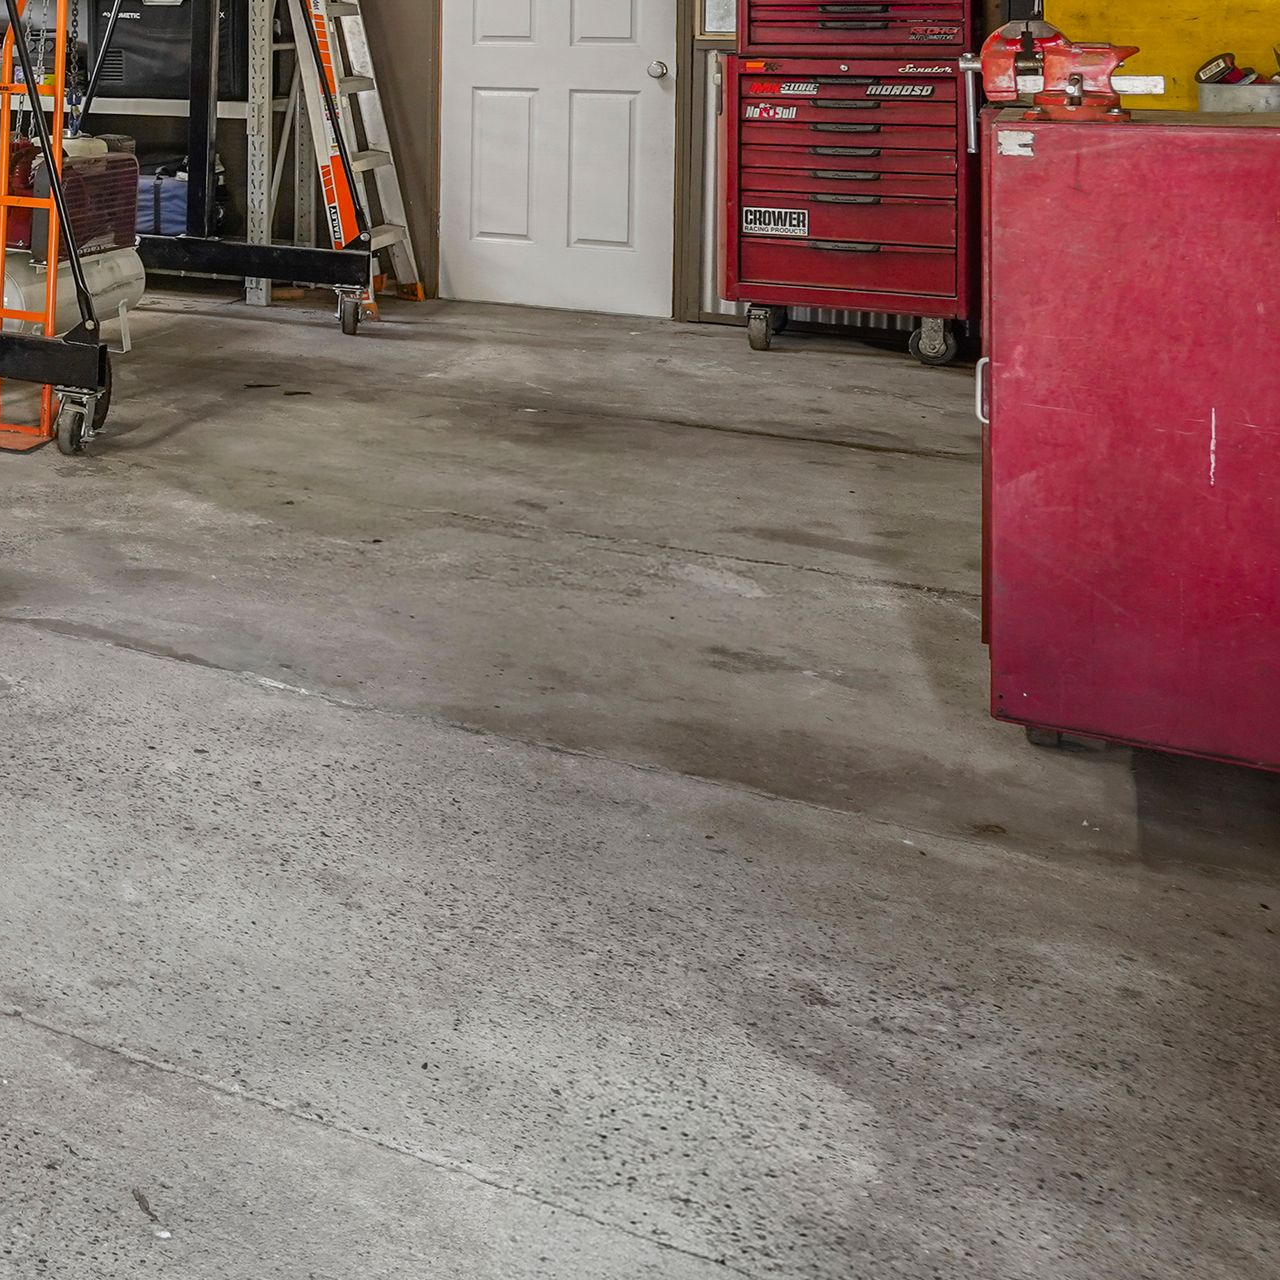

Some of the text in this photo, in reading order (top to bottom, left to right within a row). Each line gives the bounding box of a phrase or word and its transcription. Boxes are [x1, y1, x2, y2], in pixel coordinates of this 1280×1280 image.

[898, 64, 953, 73] Senator
[746, 106, 760, 117] No
[329, 206, 341, 239] BAILEY
[744, 209, 806, 228] CROWER
